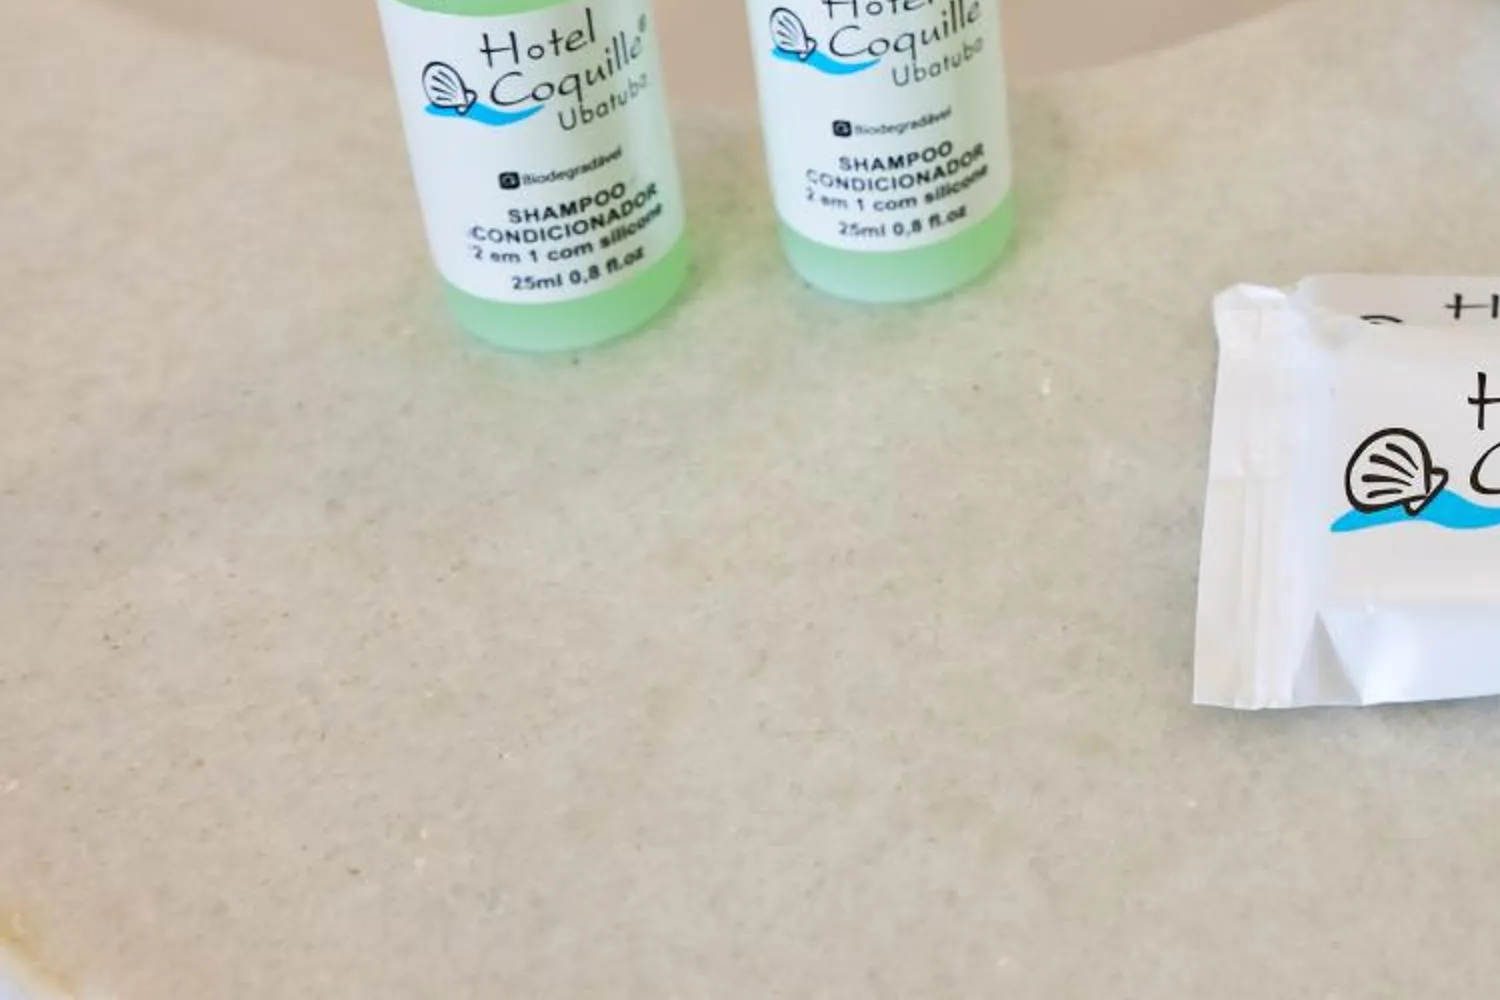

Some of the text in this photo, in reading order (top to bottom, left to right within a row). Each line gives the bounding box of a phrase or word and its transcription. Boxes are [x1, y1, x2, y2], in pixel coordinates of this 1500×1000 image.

[480, 7, 596, 69] Hotel
[891, 36, 984, 87] Ubatuba
[558, 73, 648, 131] Ubatuba
[805, 142, 985, 193] CONDICIONADOR
[838, 140, 954, 173] SHAMPOO
[470, 182, 659, 244] CONDICIONADOR
[507, 181, 627, 225] SHAMPOO
[805, 164, 989, 212] 2 em 1 com silicone
[472, 202, 664, 264] 2 em 1 com silicone
[838, 221, 886, 238] 25ml
[511, 273, 564, 291] 25ml
[569, 264, 601, 285] 0,8
